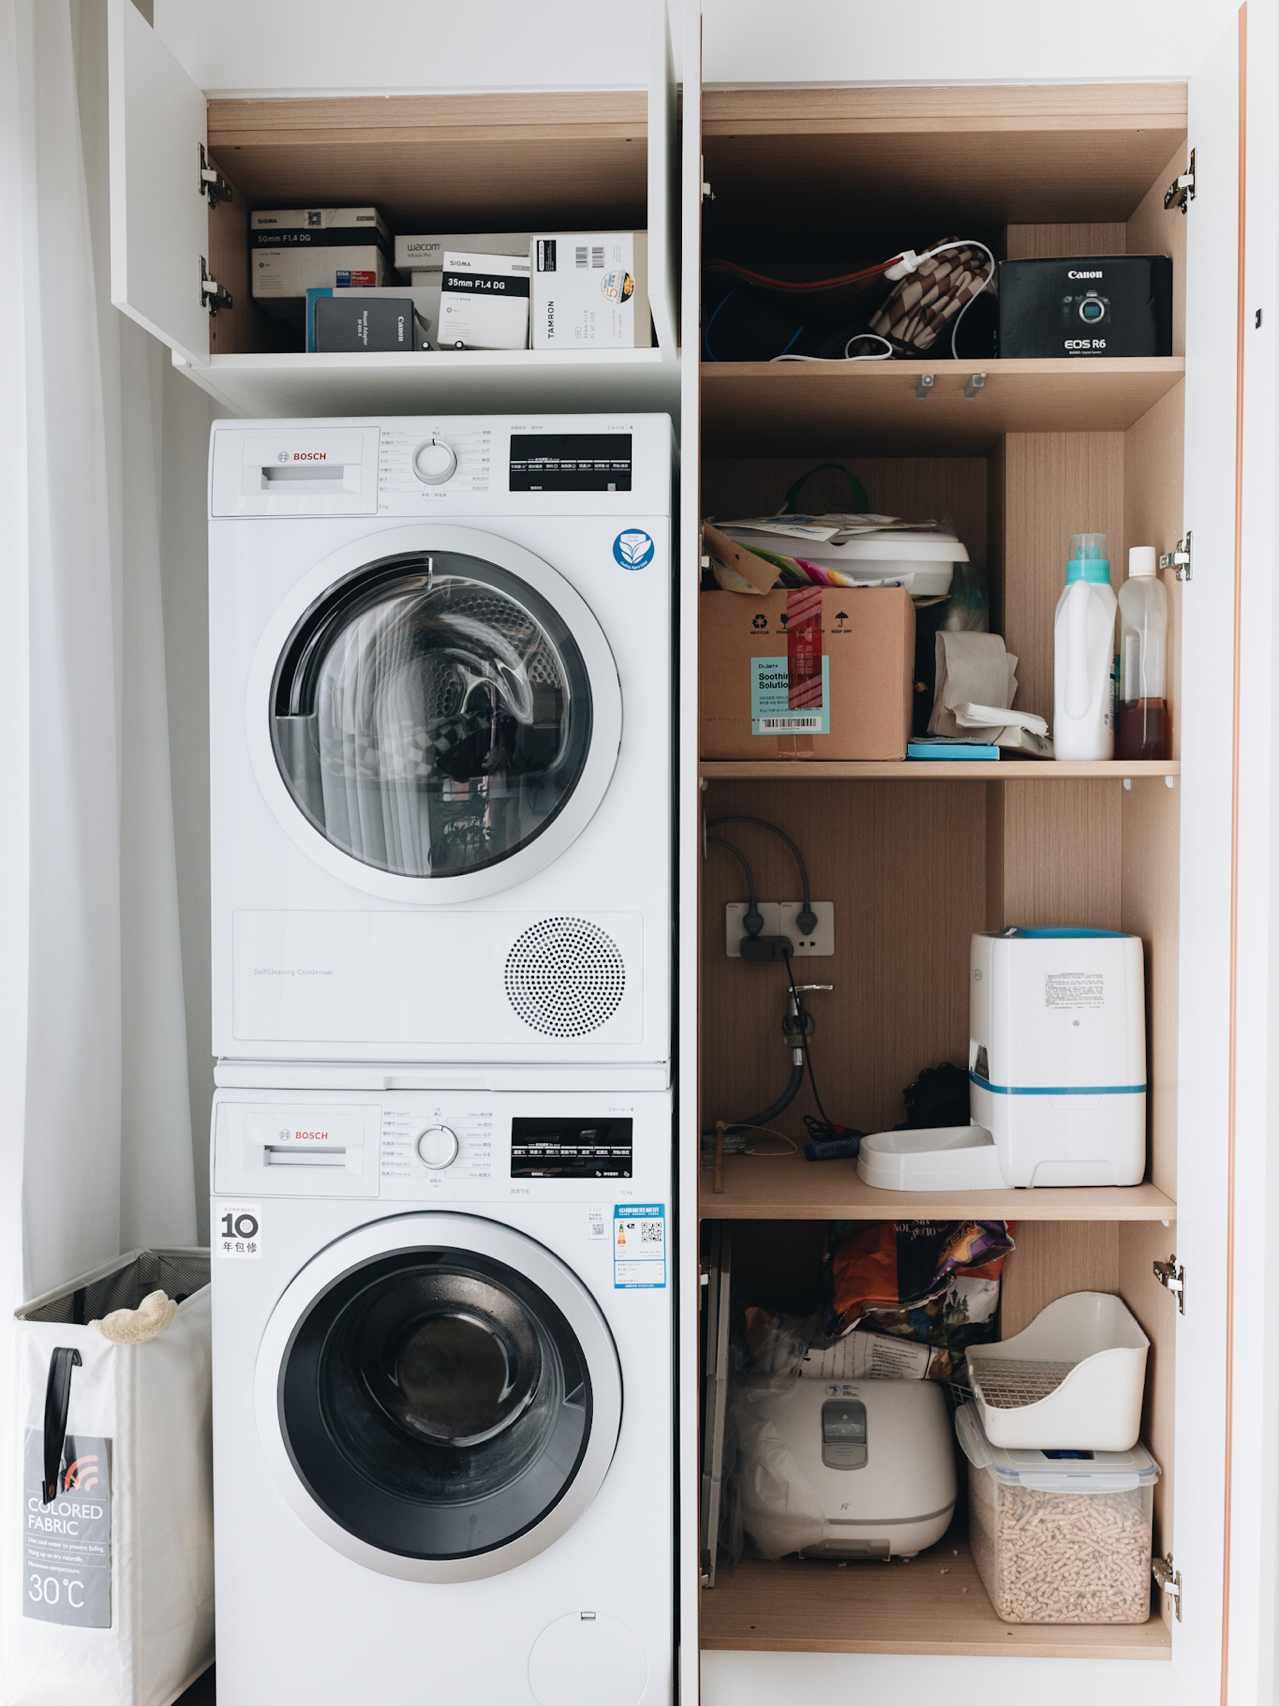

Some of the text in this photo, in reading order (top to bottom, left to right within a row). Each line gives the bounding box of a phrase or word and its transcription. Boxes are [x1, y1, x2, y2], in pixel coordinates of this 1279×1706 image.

[258, 233, 311, 243] 50mm F1.4 DG
[407, 243, 440, 252] wacom
[1068, 270, 1103, 279] Canon
[448, 278, 505, 290] 35mm F1.4 DG
[547, 300, 555, 339] TAMRON
[1064, 339, 1107, 349] EOS R6
[293, 452, 327, 461] BOSCH
[253, 968, 334, 977] SelfCleaning Condenser
[295, 1131, 328, 1140] BOSCH
[221, 1213, 259, 1239] 10
[223, 1241, 258, 1253] 年包修
[28, 1497, 103, 1520] COLORED
[28, 1514, 79, 1536] FABRIC
[27, 1536, 37, 1544] Use
[27, 1548, 40, 1557] Hang
[27, 1560, 50, 1570] Maximum
